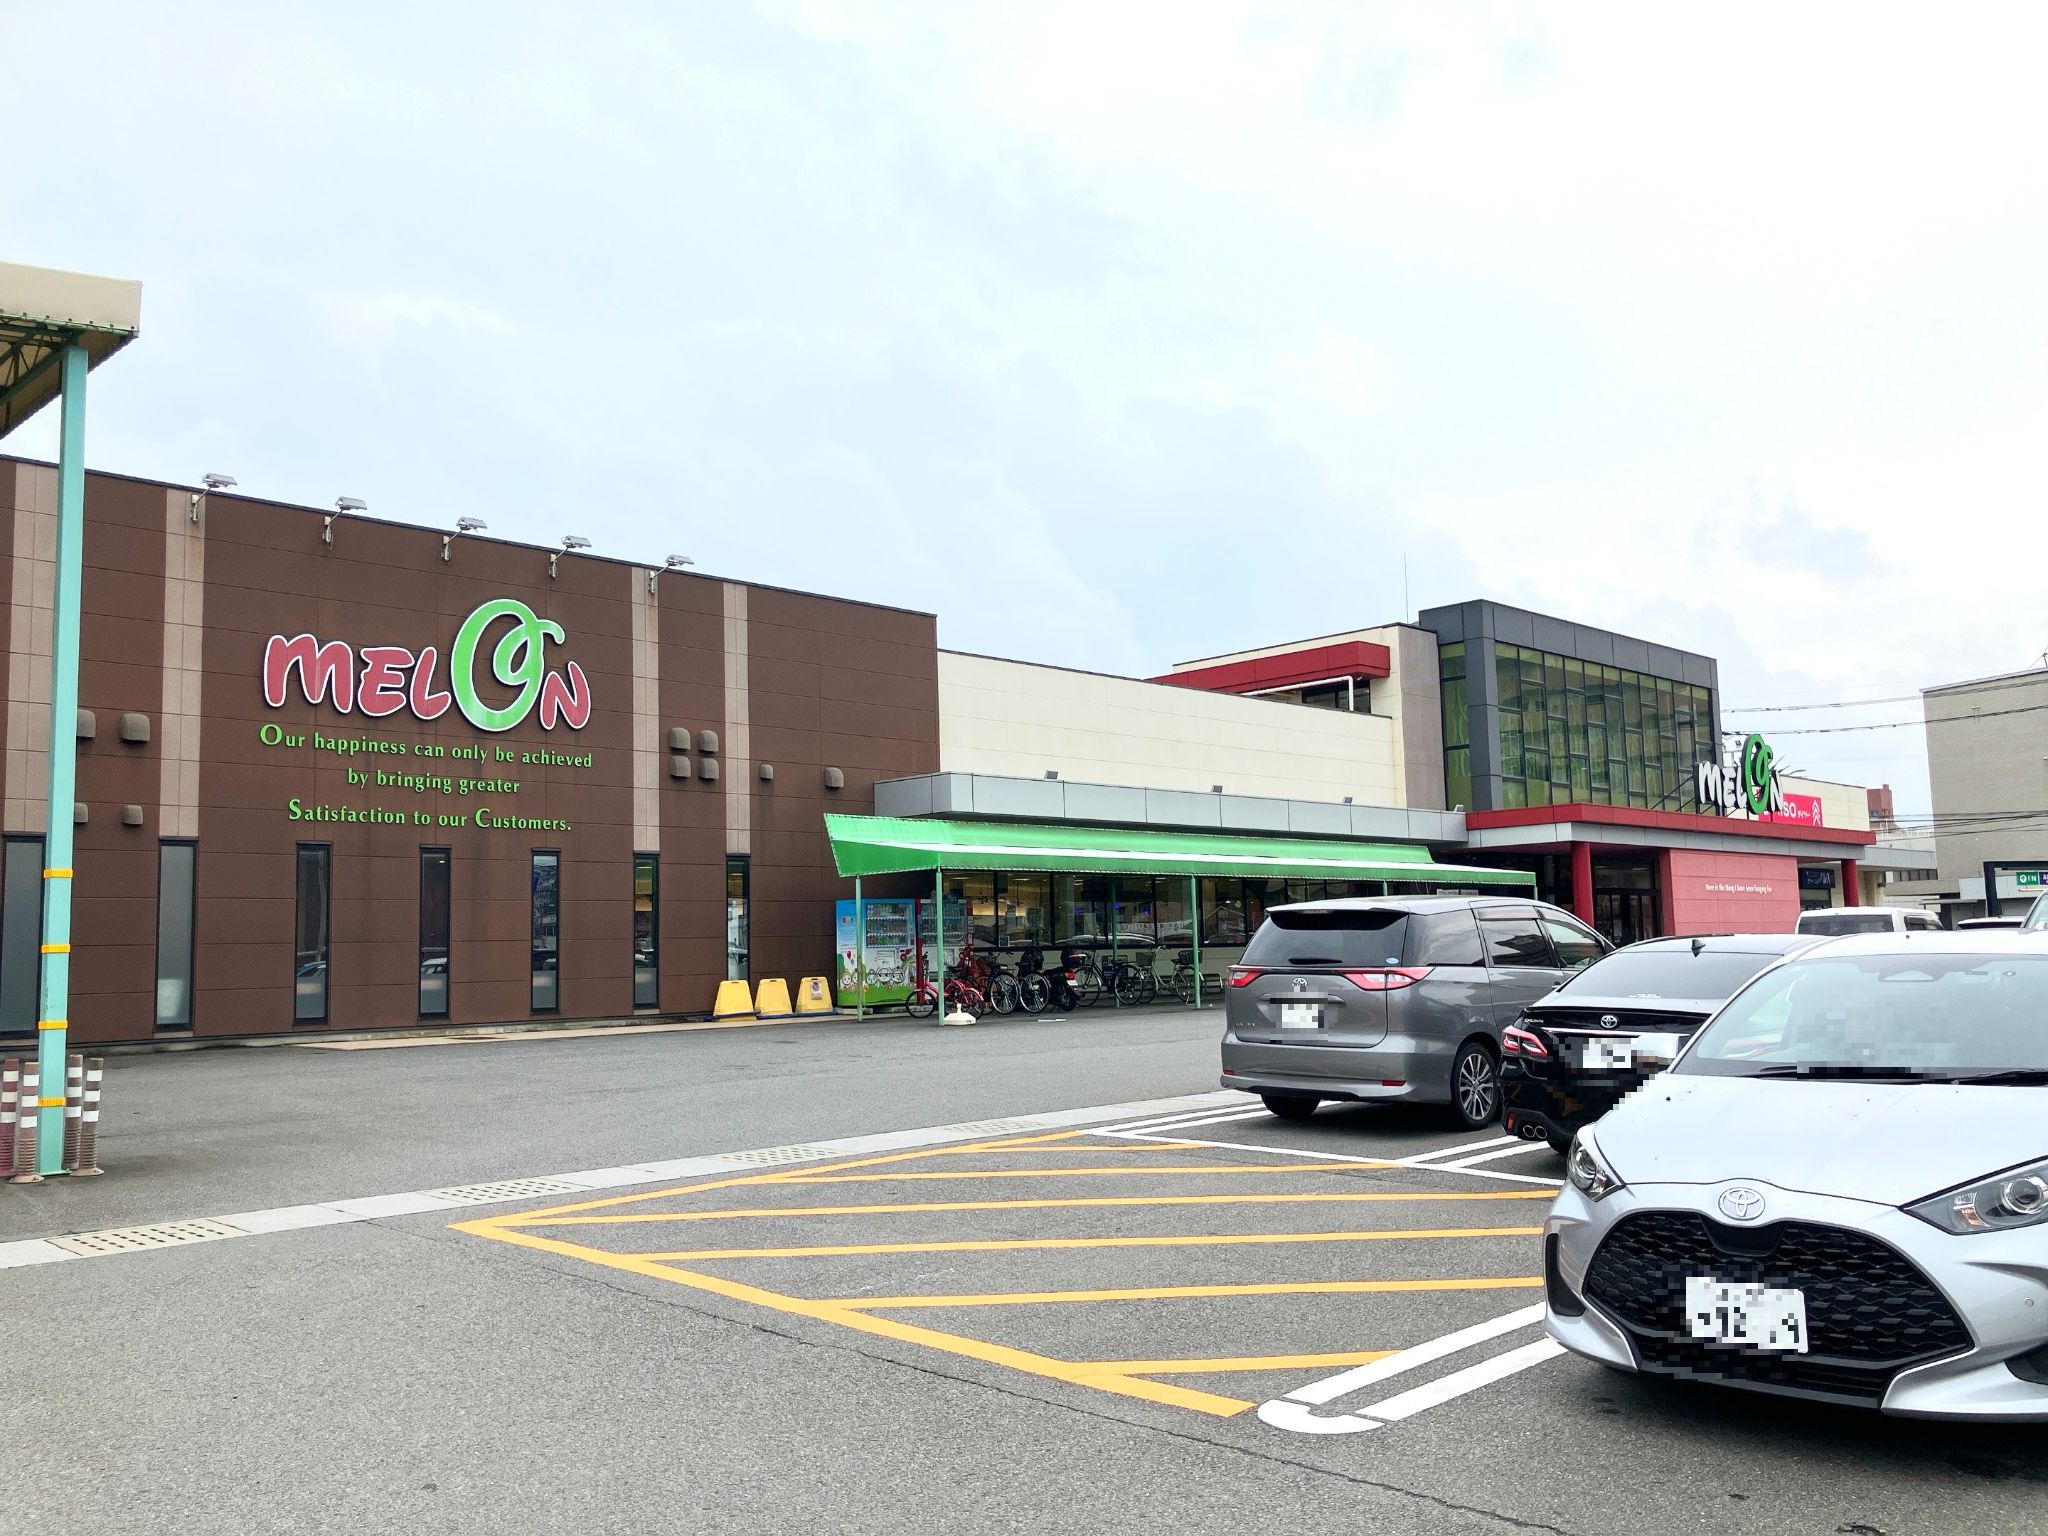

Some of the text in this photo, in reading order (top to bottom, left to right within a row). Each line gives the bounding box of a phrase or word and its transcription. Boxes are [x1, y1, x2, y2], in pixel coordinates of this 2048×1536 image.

[263, 599, 591, 732] MELON
[260, 724, 593, 768] Our happiness can only be achieved
[347, 768, 520, 795] by bringing greater
[1697, 734, 1784, 814] MELON
[288, 799, 572, 832] Satisfaction to our Customers.
